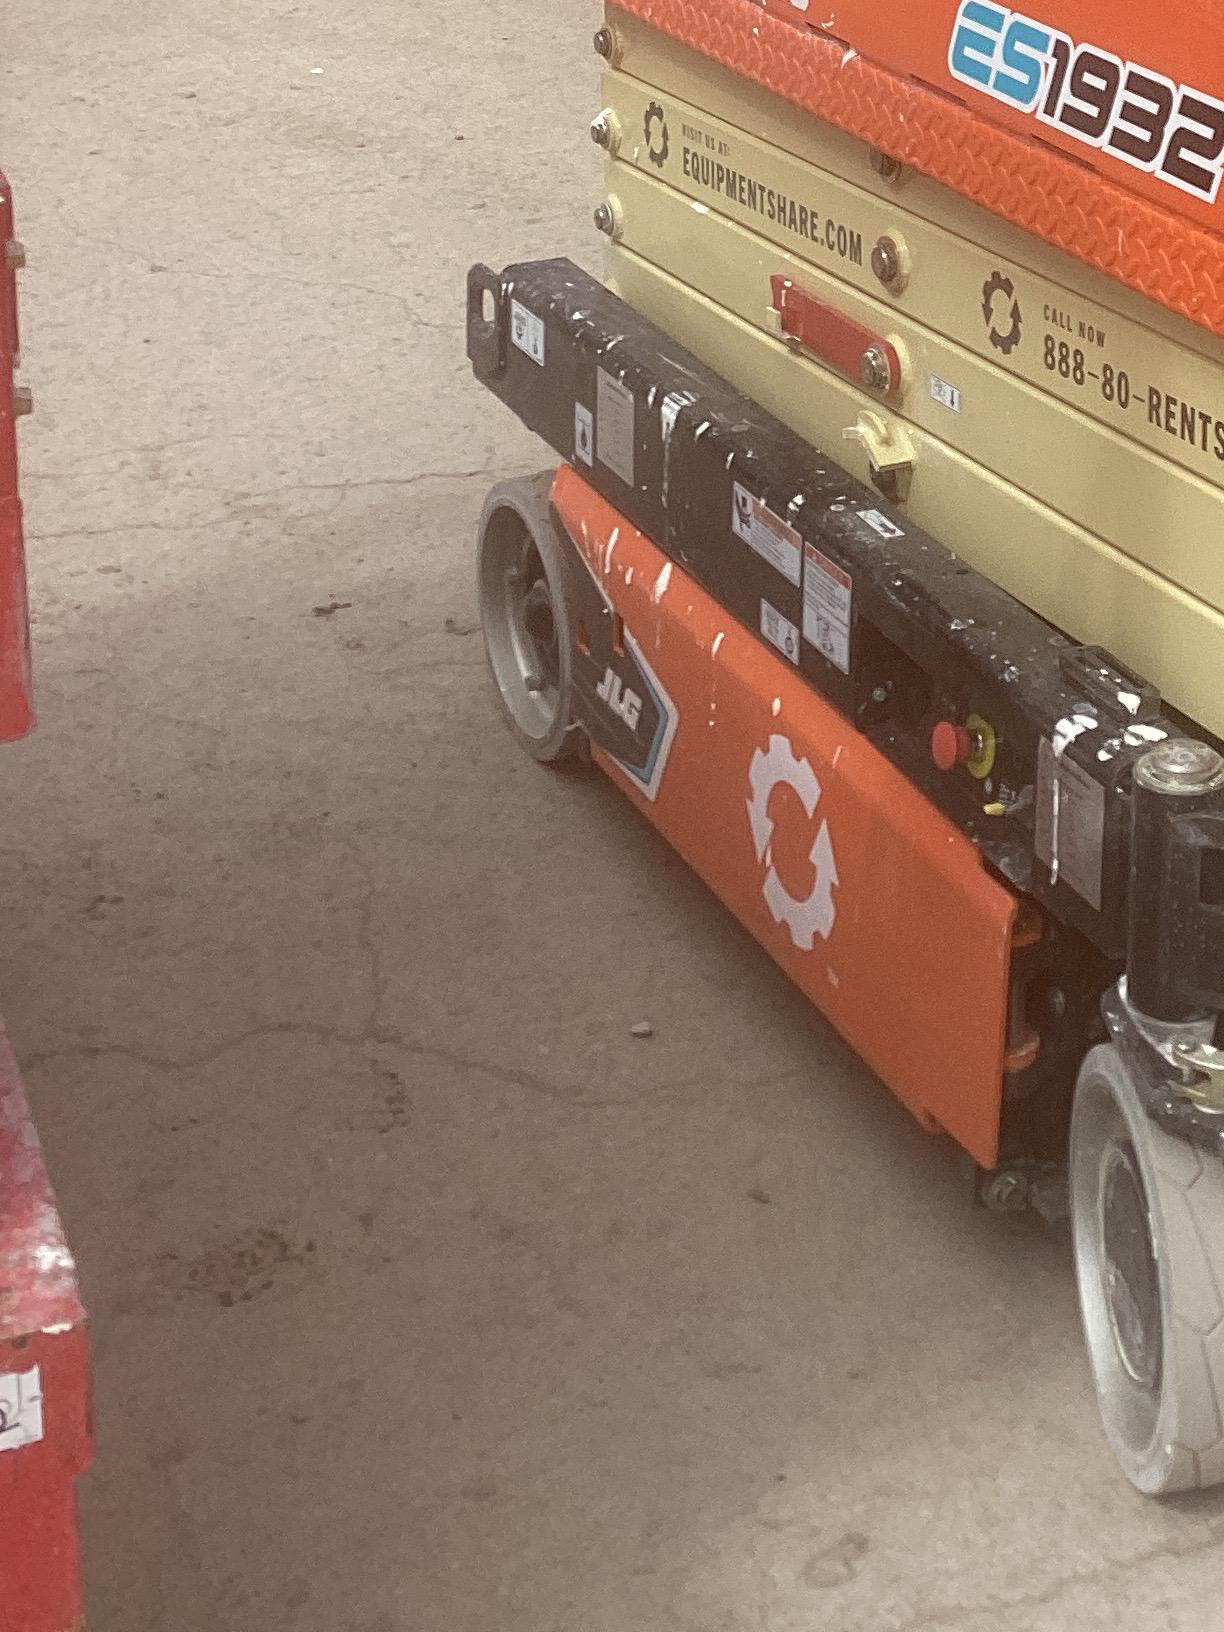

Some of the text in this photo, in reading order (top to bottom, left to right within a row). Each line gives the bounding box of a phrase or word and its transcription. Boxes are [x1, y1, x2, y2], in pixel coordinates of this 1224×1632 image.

[682, 146, 863, 267] EQUIPMENTSHARE.COM
[1043, 303, 1106, 348] CALL NOW
[596, 665, 643, 731] JLG
